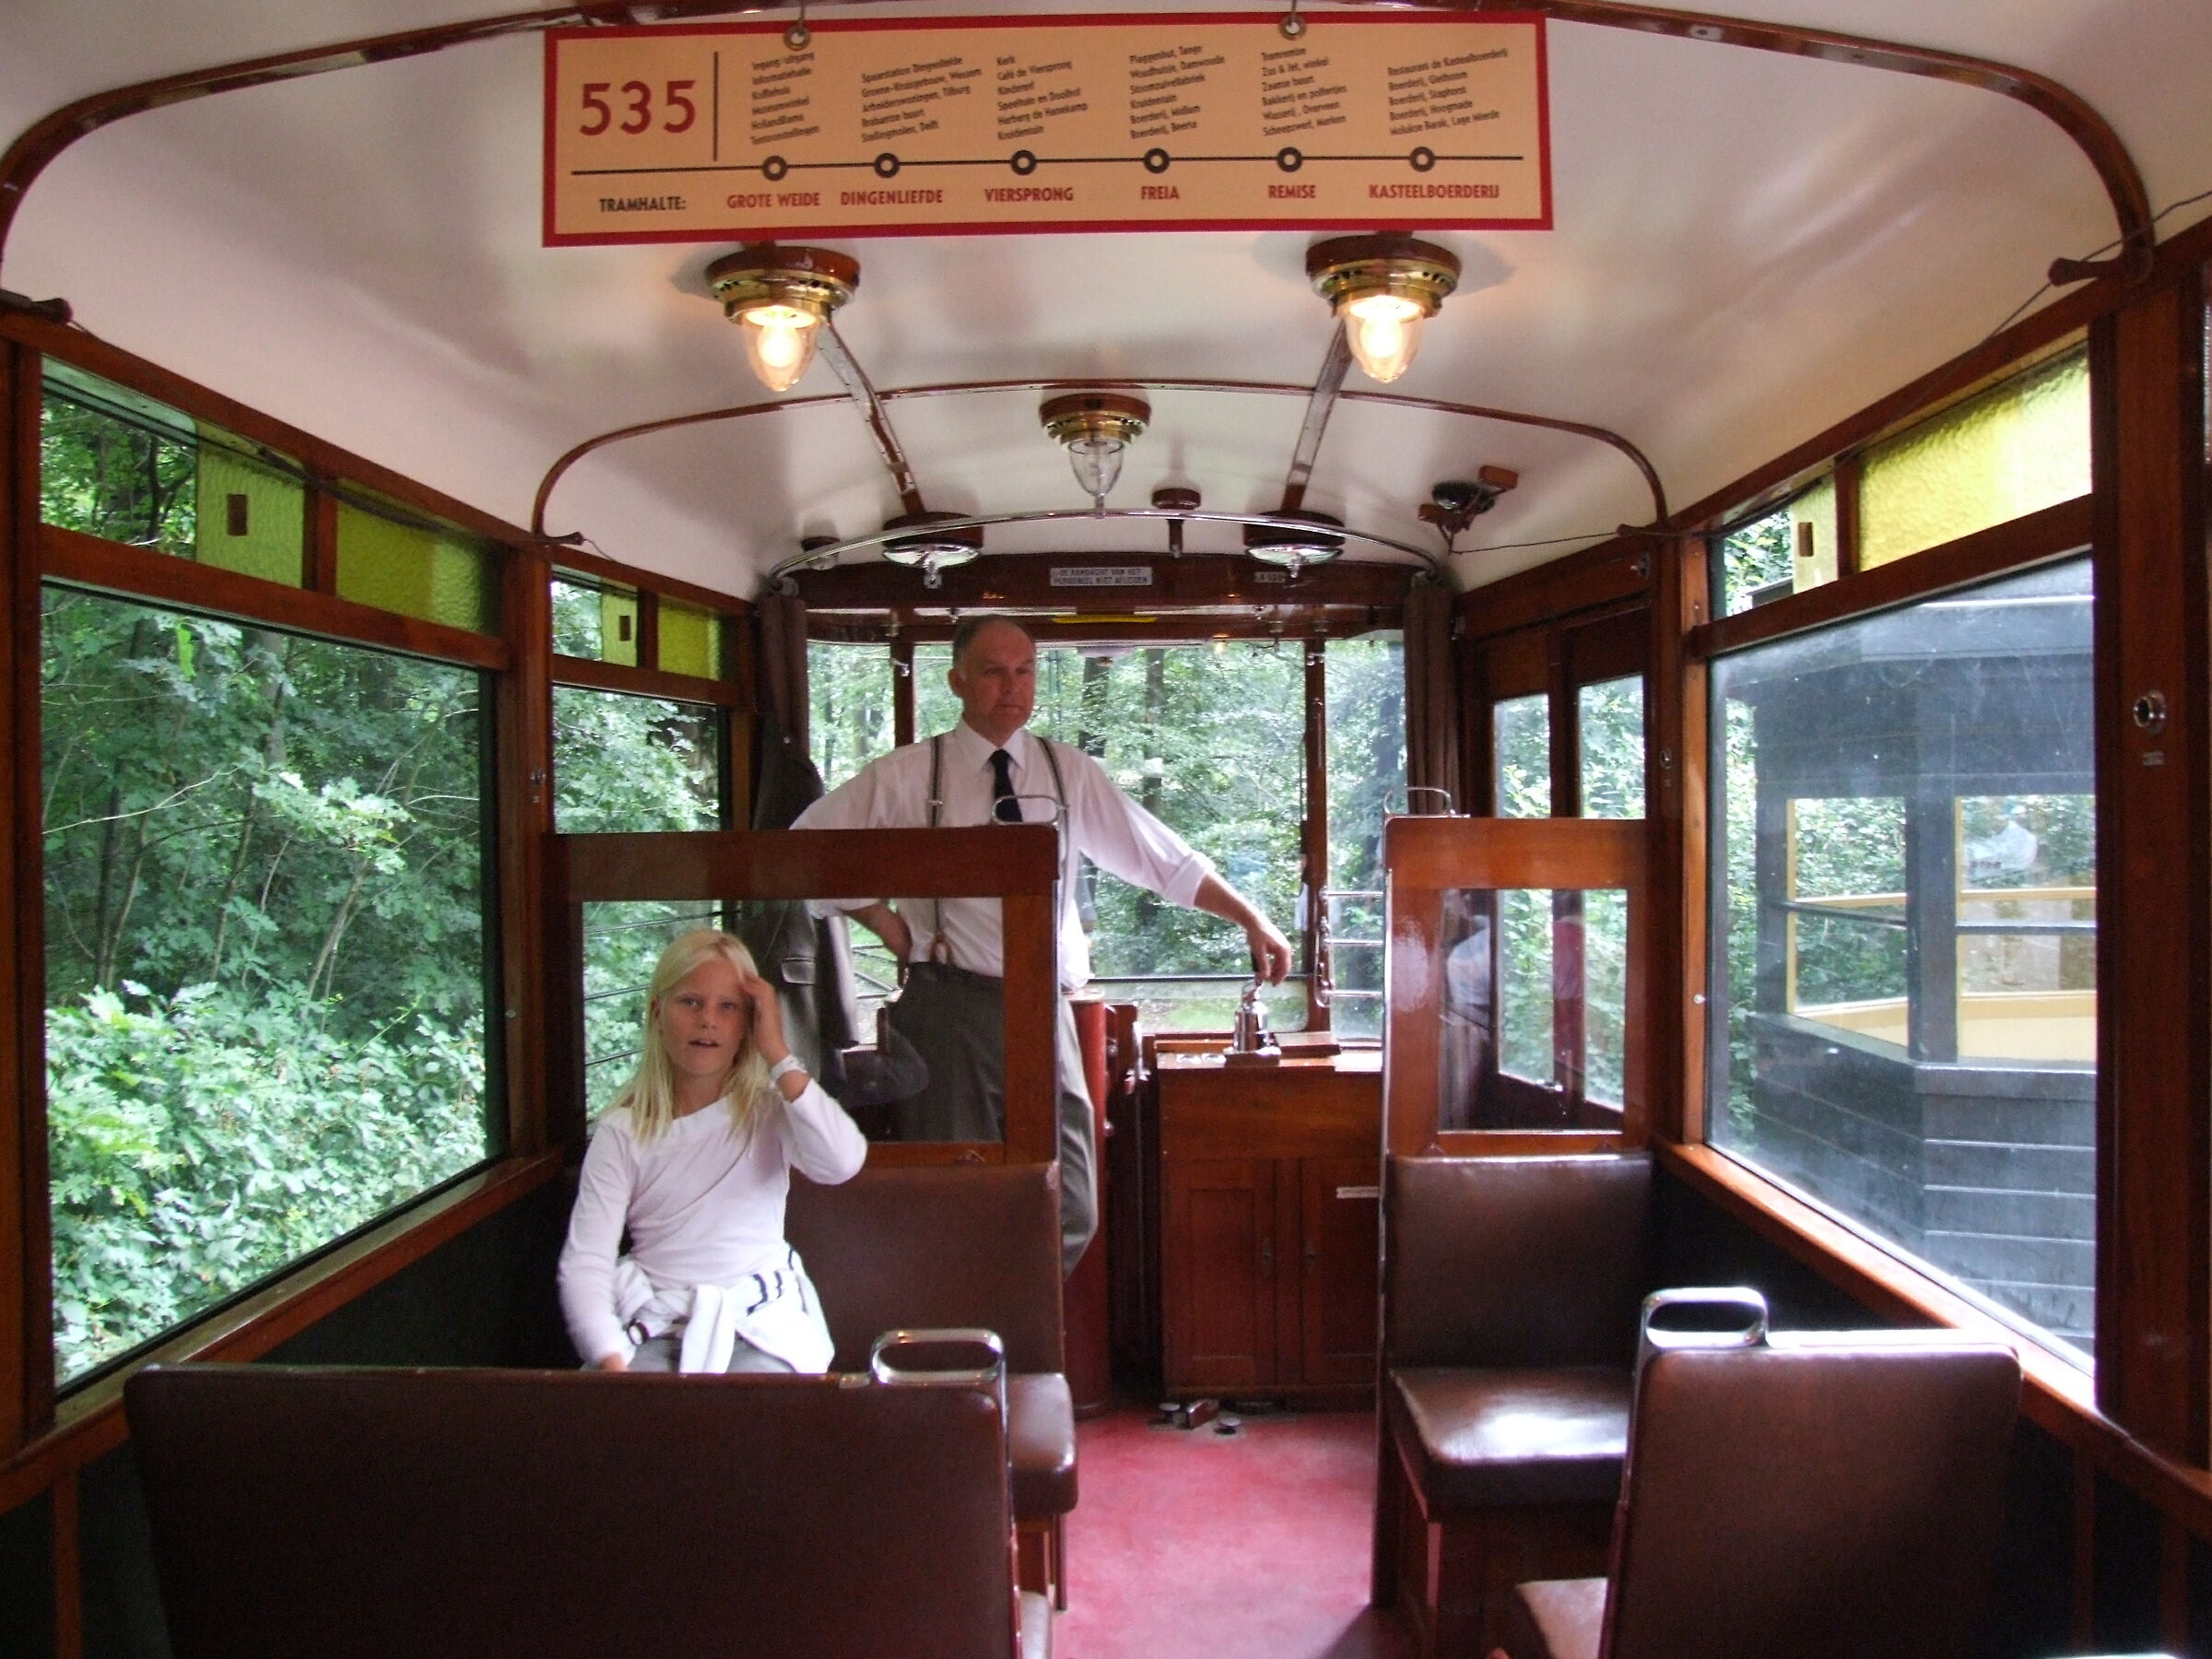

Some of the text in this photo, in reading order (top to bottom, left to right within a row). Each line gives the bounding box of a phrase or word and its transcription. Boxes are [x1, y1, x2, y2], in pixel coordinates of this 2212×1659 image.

[997, 61, 1072, 80] Café de Viersprong
[1431, 60, 1441, 68] de
[943, 86, 971, 96] Tilburg
[1297, 92, 1307, 100] en
[580, 80, 696, 135] 535
[997, 98, 1035, 111] Speeltuin
[997, 103, 1088, 125] Herberg de Hanekamp
[841, 189, 944, 206] DINGENLIEFDE
[984, 187, 1074, 202] VIERSPRONG
[1140, 185, 1180, 200] FREIA
[1267, 184, 1316, 199] REMISE
[1369, 184, 1500, 199] KASTEELBOERDERIJ
[599, 195, 687, 212] TRAMHALTE:
[727, 192, 820, 209] GROTE WEIDE
